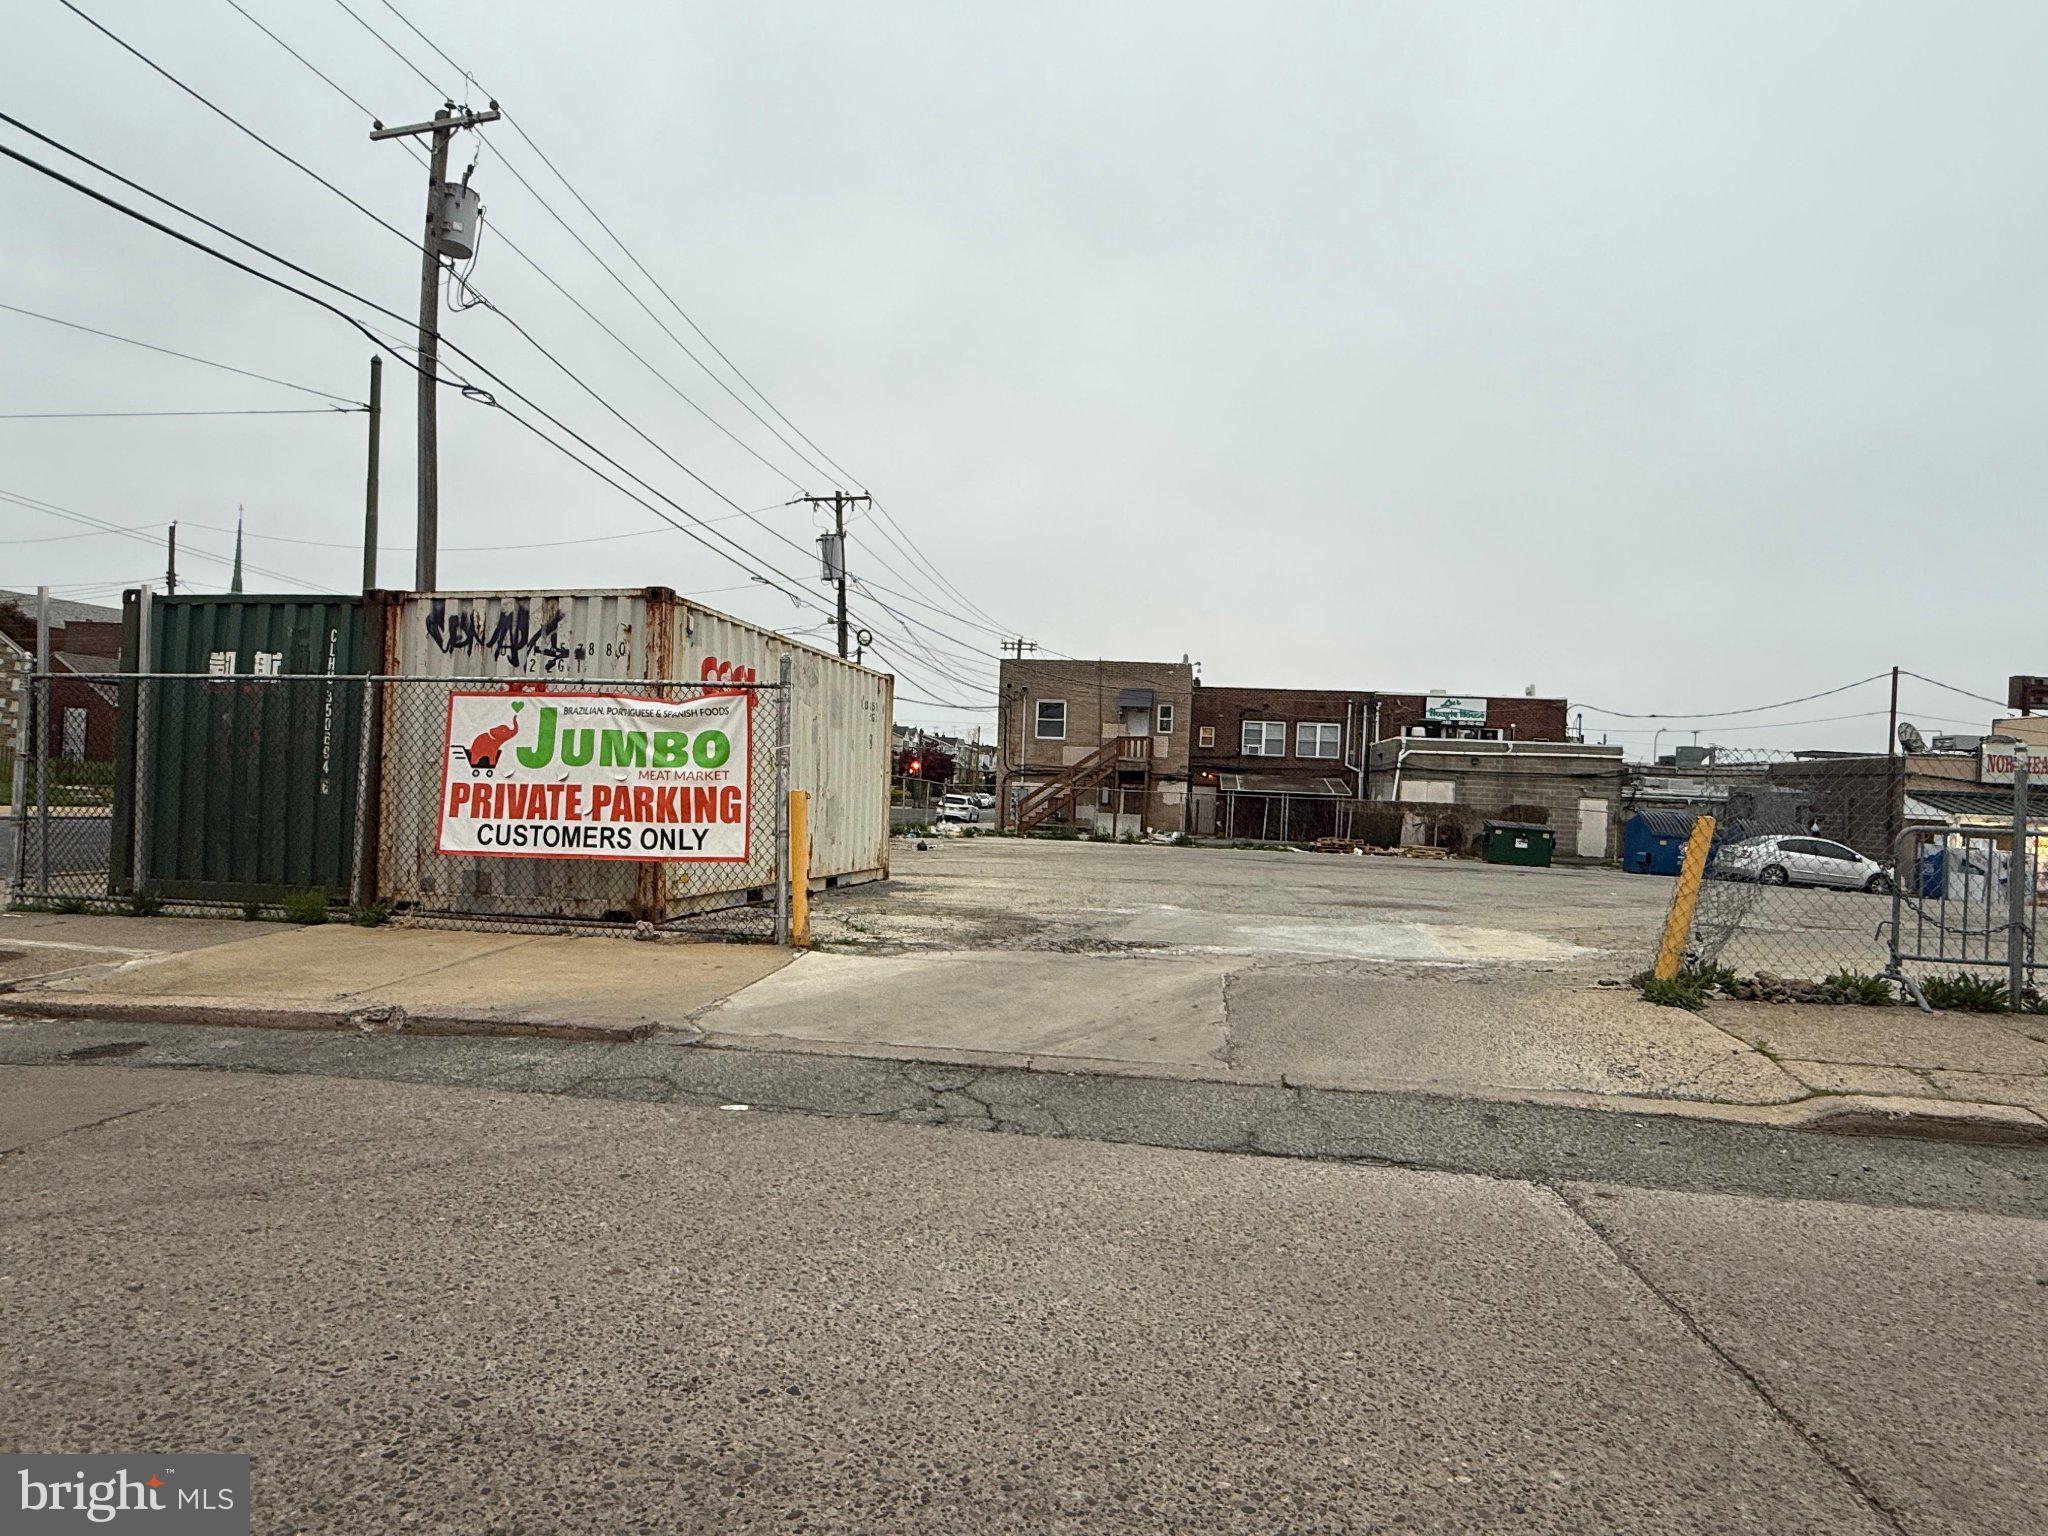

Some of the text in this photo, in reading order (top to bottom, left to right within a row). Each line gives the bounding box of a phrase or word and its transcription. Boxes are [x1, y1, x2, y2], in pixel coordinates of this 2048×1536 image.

[606, 706, 655, 718] PORTUGUESE
[655, 709, 662, 718] &
[663, 709, 698, 719] SPANISH
[699, 706, 730, 718] FOODS
[516, 707, 731, 769] JUMBO
[638, 770, 730, 782] MEAT MARKET
[449, 782, 742, 824] PRIVATE PARKING
[476, 823, 709, 851] CUSTOMERS ONLY
